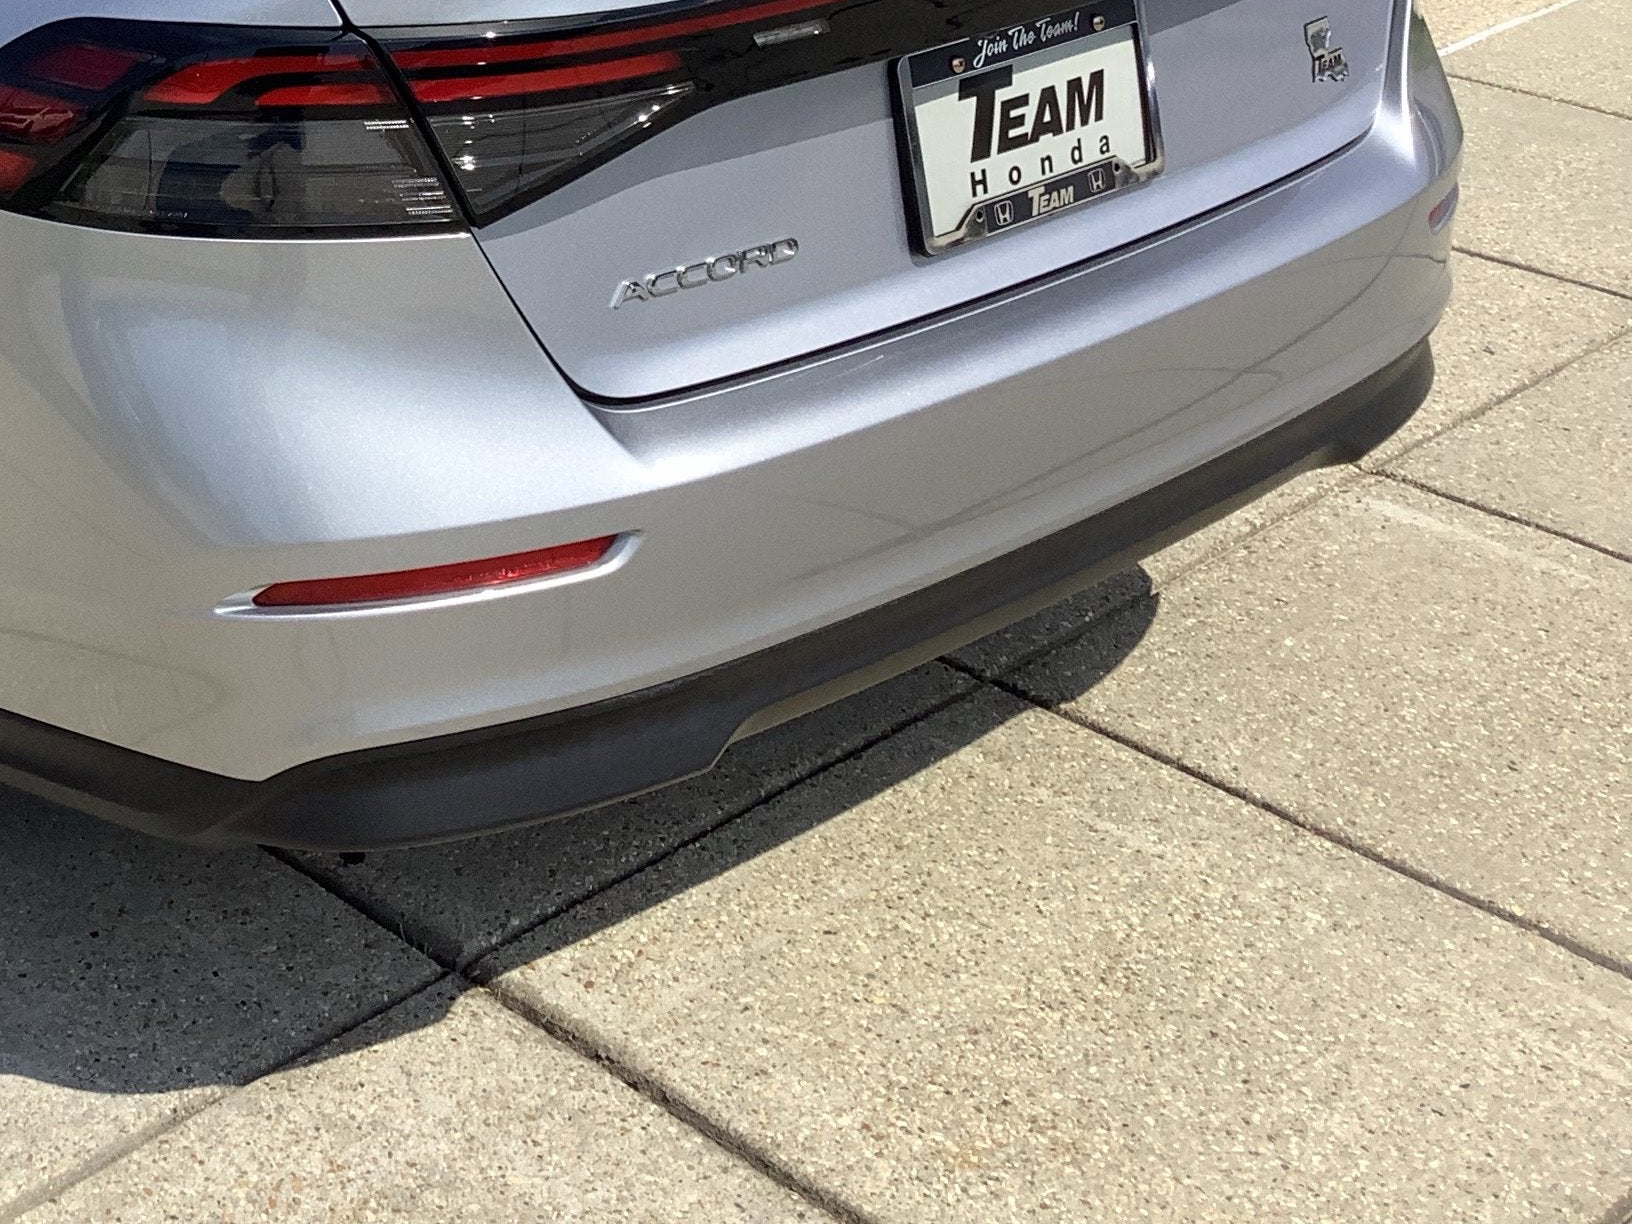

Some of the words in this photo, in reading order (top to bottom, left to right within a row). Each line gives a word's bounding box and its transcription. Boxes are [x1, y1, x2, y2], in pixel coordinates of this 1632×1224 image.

[972, 36, 1008, 68] Join
[1008, 26, 1035, 51] The
[1035, 11, 1081, 42] Team!
[1314, 53, 1344, 74] TEAM
[958, 64, 1105, 164] TEAM
[970, 135, 1111, 198] Honda
[1027, 185, 1074, 217] TEAM
[609, 237, 800, 310] ACCORD
